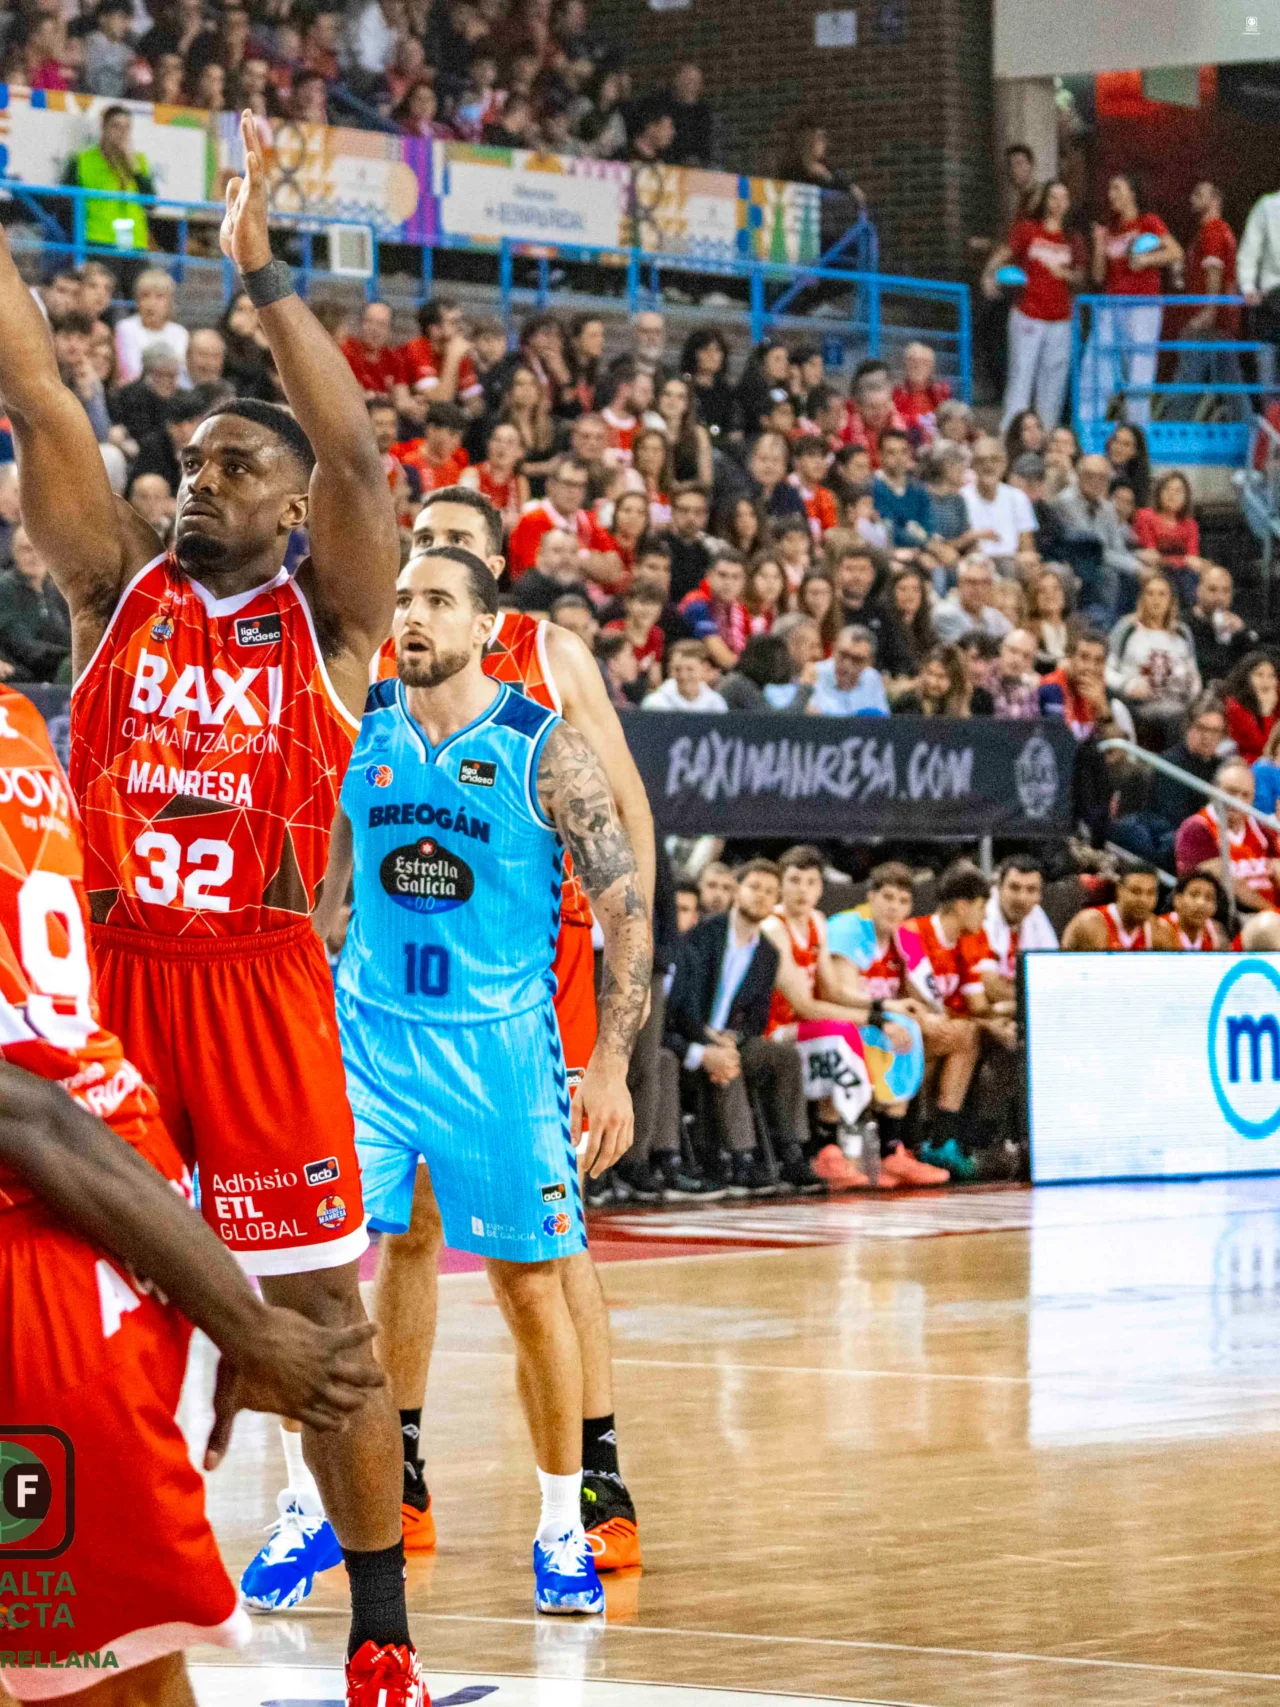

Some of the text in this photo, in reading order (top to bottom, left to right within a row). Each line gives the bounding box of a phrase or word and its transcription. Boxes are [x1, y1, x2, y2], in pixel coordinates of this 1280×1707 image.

[240, 627, 259, 636] liga
[241, 631, 281, 643] endesa
[129, 648, 283, 726] BAXI
[121, 716, 278, 755] CLIMATIZACIÓN
[126, 760, 253, 808] MANRESA
[368, 803, 491, 844] BREOGÁN
[135, 831, 235, 912] 32
[394, 856, 459, 879] Estrella
[396, 874, 457, 896] Galicia
[404, 943, 449, 997] 10
[213, 1169, 298, 1193] Adbisio
[310, 1168, 333, 1183] acb
[544, 1190, 562, 1201] acb
[215, 1196, 264, 1219] ETL
[220, 1219, 308, 1241] GLOBAL
